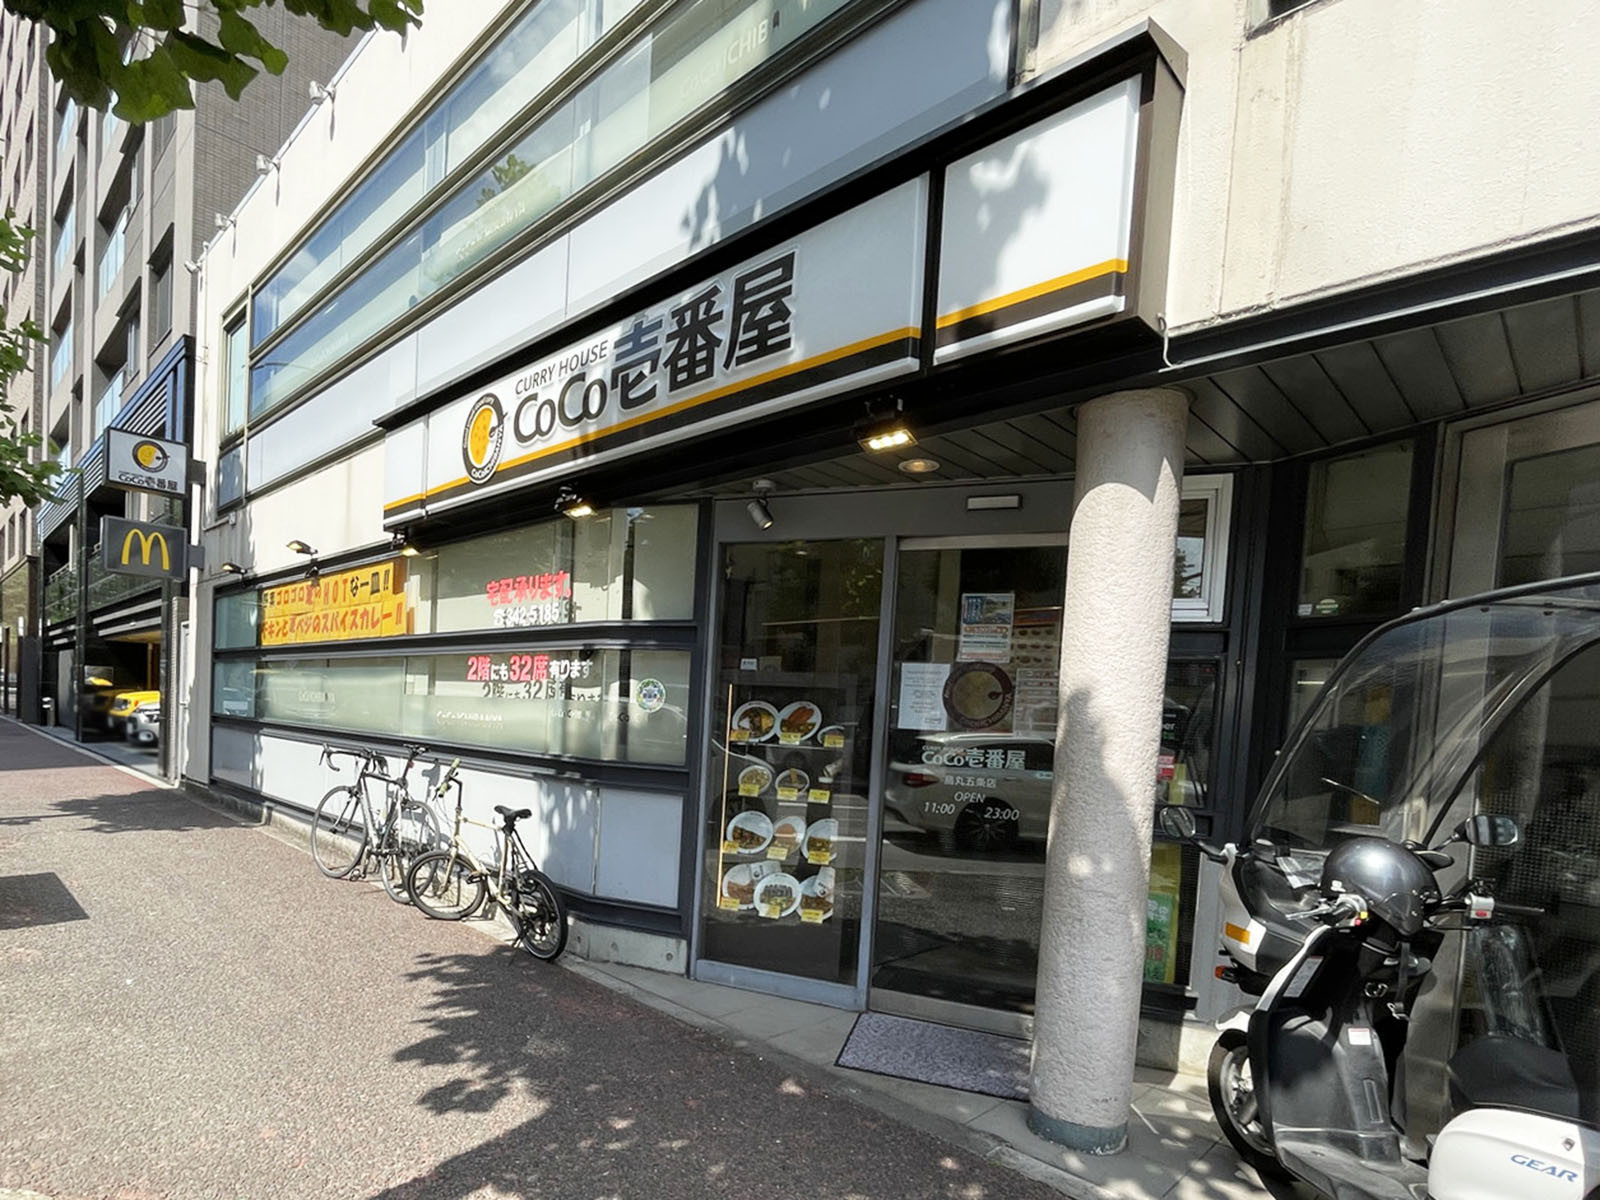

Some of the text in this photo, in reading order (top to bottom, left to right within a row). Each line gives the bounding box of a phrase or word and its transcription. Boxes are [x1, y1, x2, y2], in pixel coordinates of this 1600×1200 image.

[513, 251, 796, 444] CoCo壱番屋
[515, 340, 608, 395] CURRY HOUSE
[467, 653, 593, 681] 2階にも32席有ります
[922, 748, 1026, 770] CoCo壱番屋
[924, 802, 956, 815] 11:00
[984, 807, 1020, 820] 23:00
[954, 791, 986, 803] OPEN
[1511, 1154, 1578, 1183] GEAR
